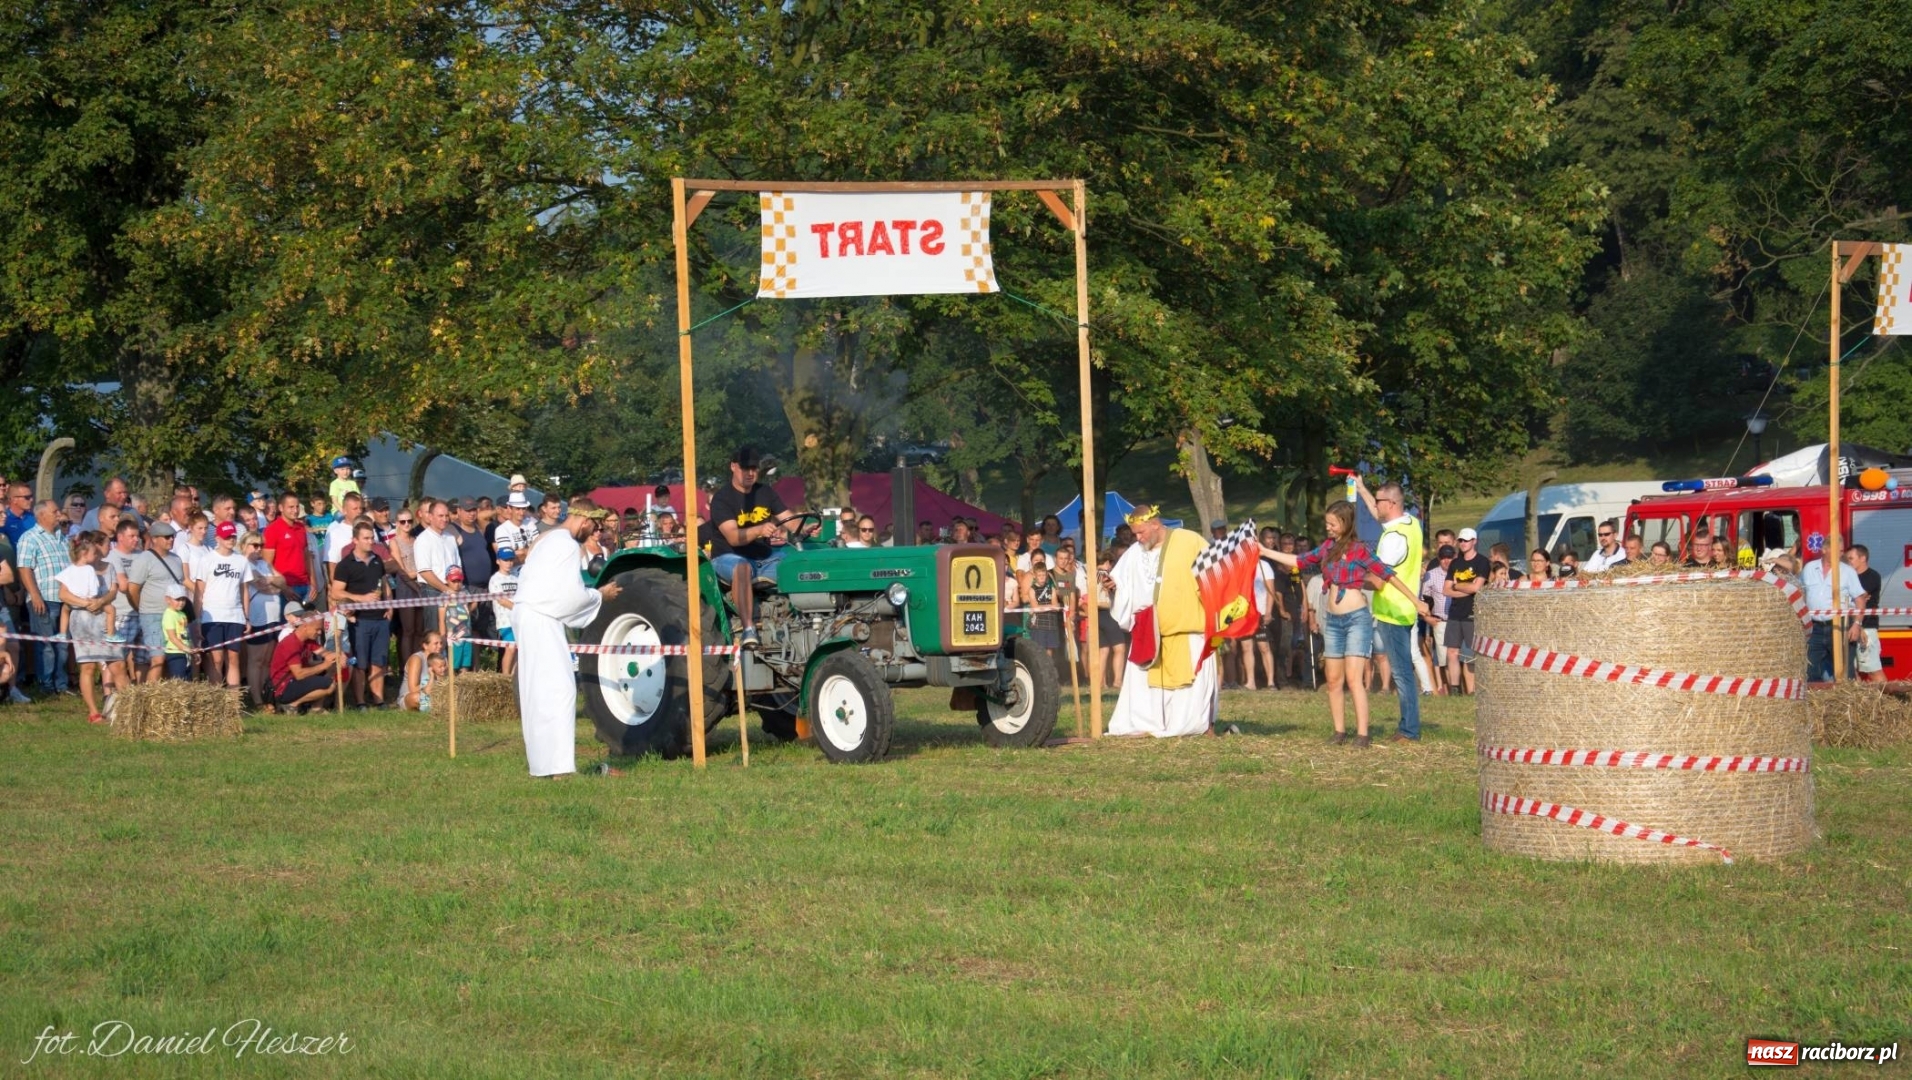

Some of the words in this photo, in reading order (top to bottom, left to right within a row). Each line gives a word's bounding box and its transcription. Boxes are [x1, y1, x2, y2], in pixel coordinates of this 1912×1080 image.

[1862, 490, 1888, 501] 998
[958, 594, 994, 602] URSUS
[965, 613, 983, 622] KAH
[965, 623, 985, 632] 2042
